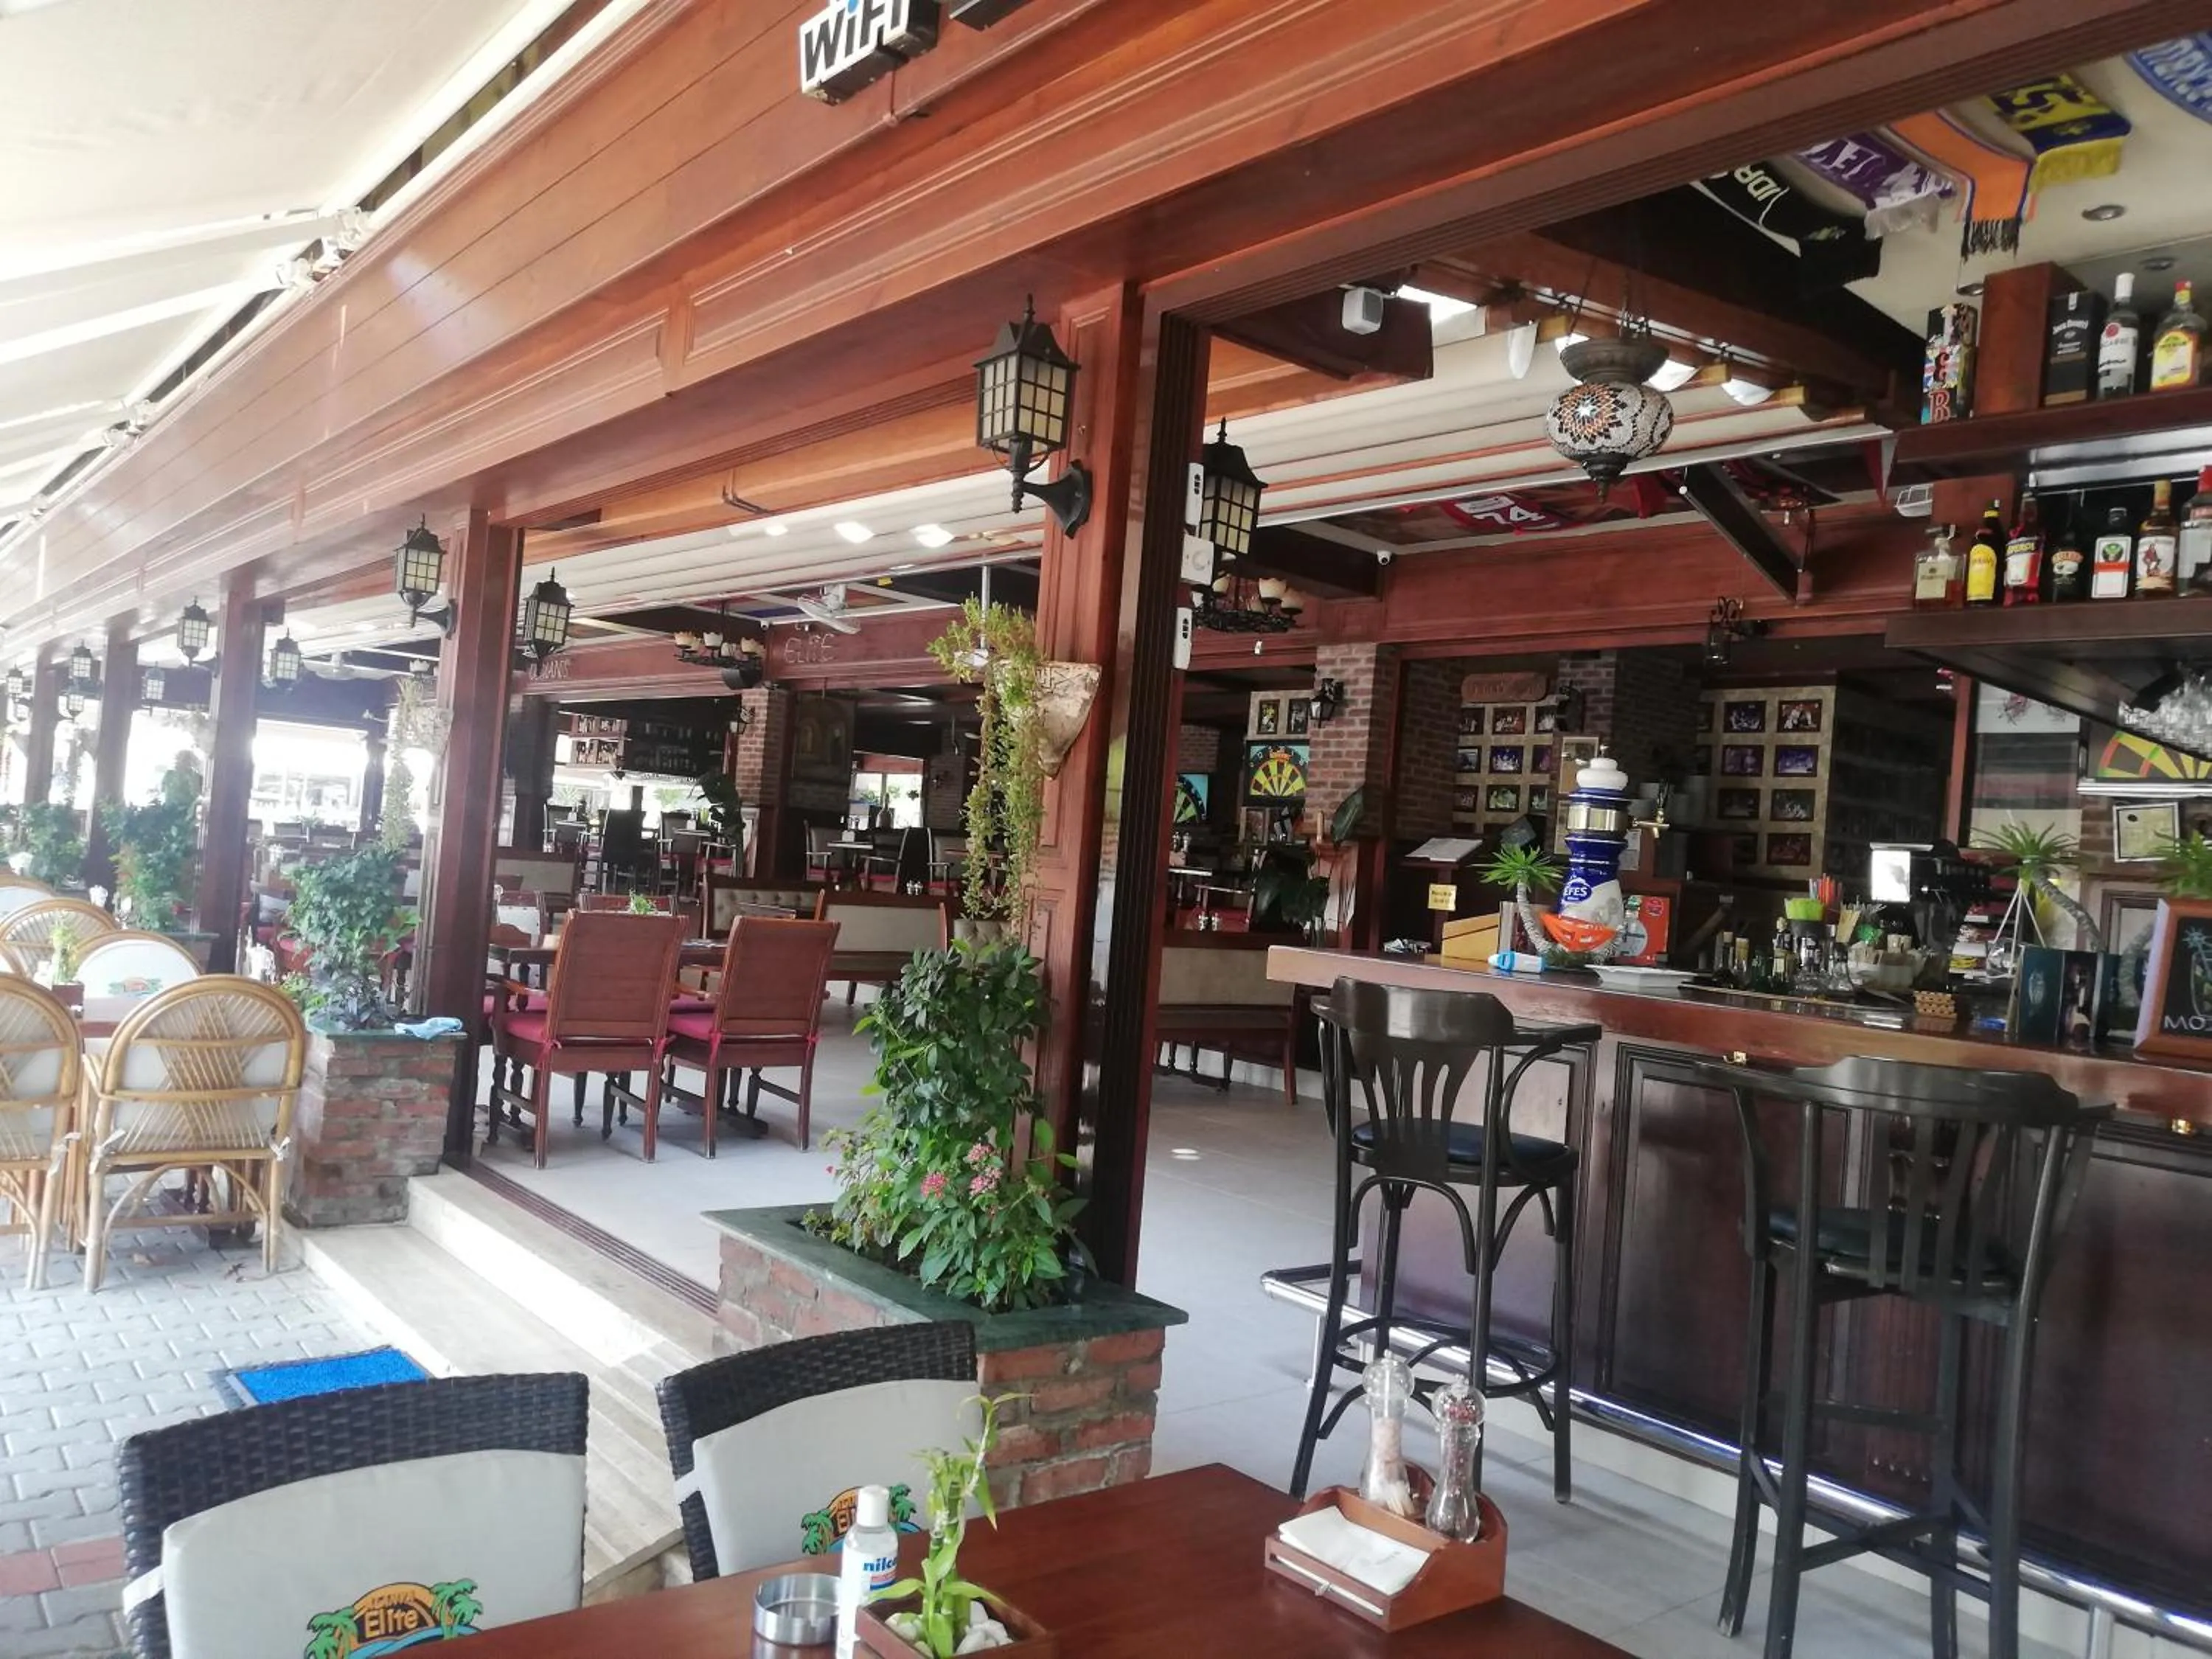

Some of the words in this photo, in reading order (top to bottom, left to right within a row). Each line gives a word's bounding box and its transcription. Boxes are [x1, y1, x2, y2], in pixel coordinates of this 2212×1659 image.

[1564, 887, 1588, 897] EFES
[2164, 1014, 2212, 1032] MO
[365, 1608, 419, 1639] Elite
